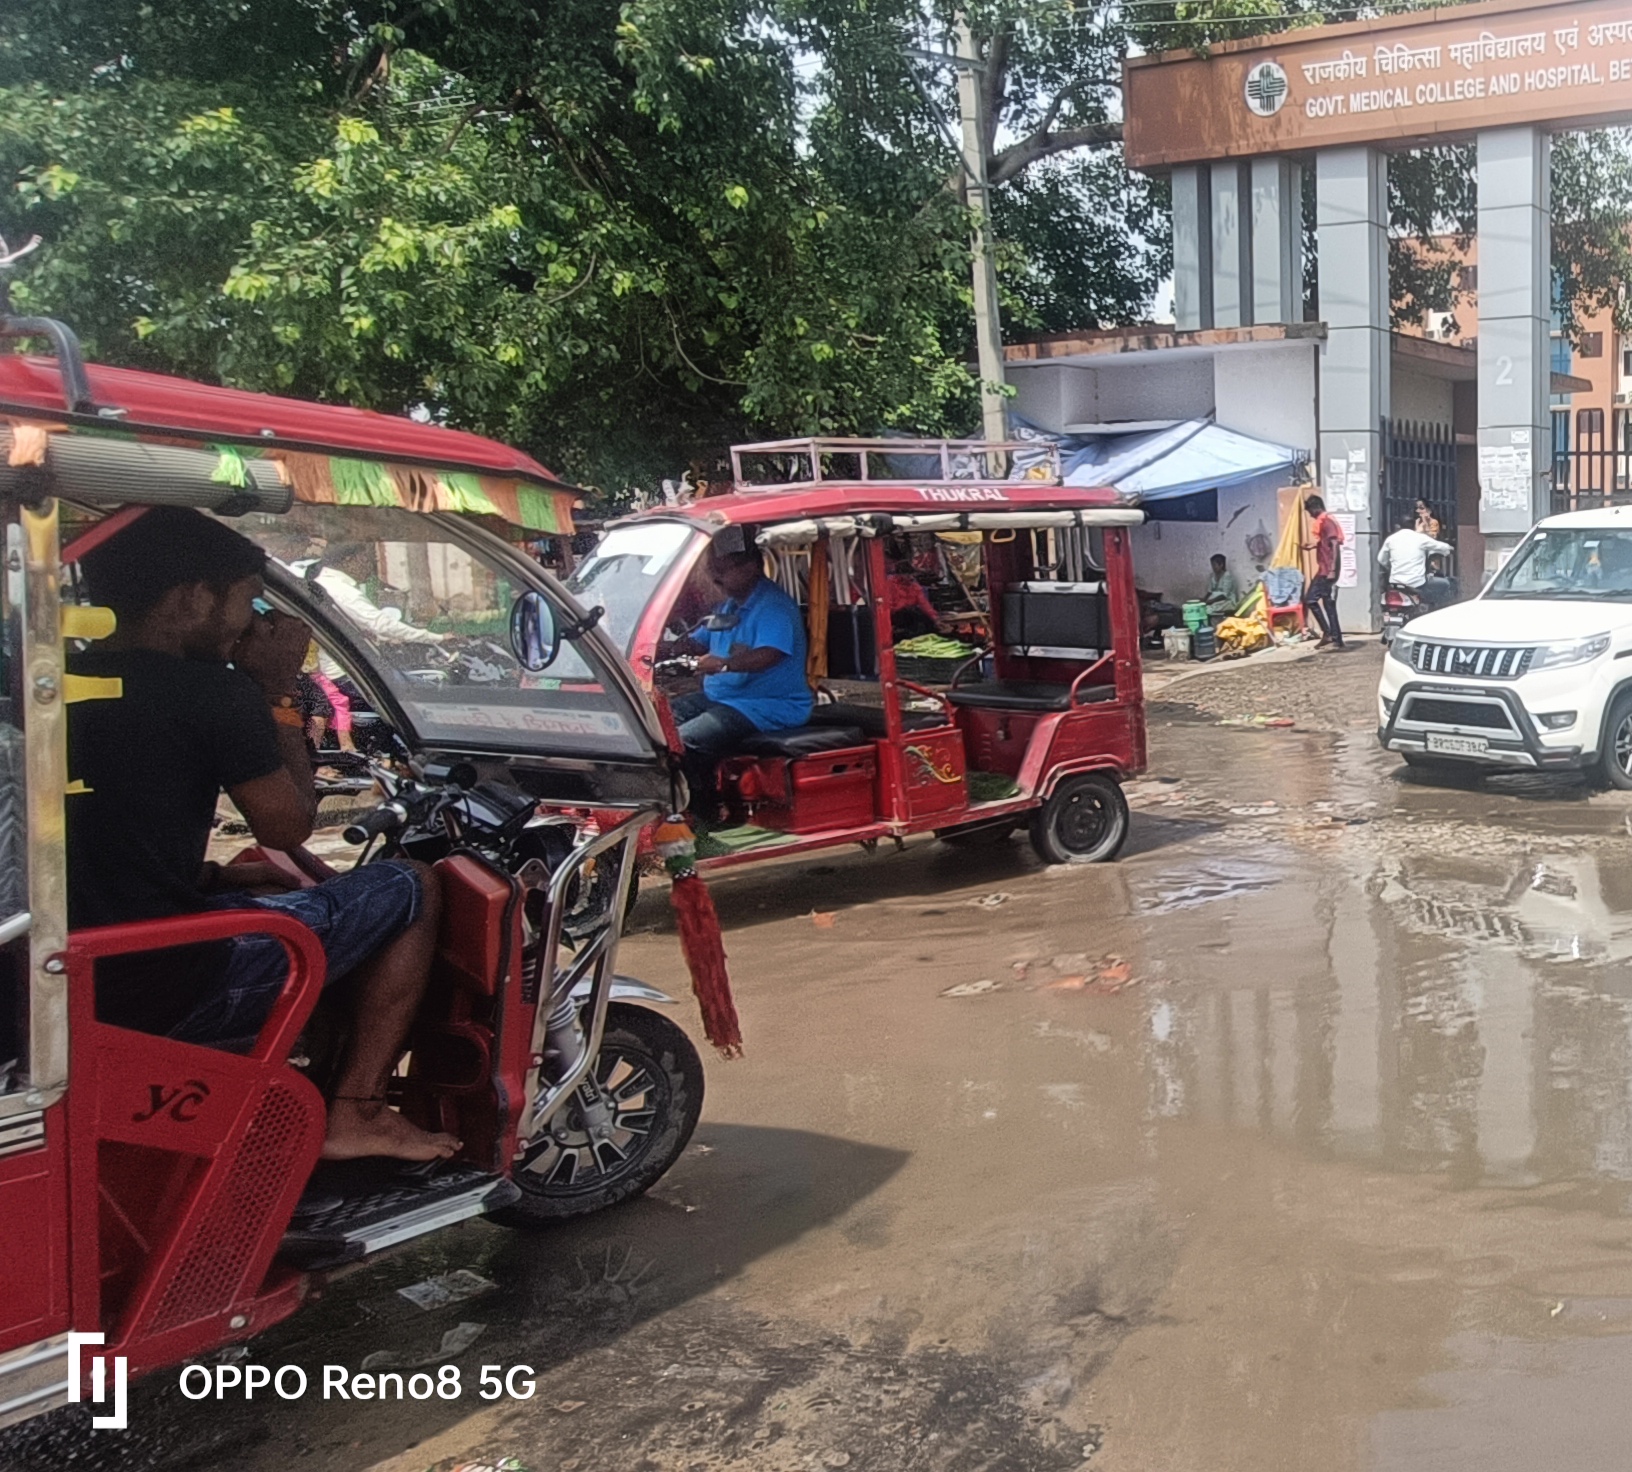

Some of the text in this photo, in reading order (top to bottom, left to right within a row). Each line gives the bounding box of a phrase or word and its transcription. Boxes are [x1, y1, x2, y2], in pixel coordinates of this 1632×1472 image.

[1302, 50, 1368, 86] राजकीय
[1374, 43, 1442, 77] चिकित्सा
[1448, 32, 1547, 70] महाविद्यालय
[1554, 20, 1579, 56] एवं
[1305, 95, 1347, 118] GOVT.
[1349, 87, 1413, 114] MEDICAL
[1415, 78, 1486, 105] COLLEGE
[1488, 73, 1521, 97] AND
[1524, 63, 1605, 92] HOSPITAL,
[1495, 354, 1513, 386] 2
[914, 487, 1010, 502] THUKRAL
